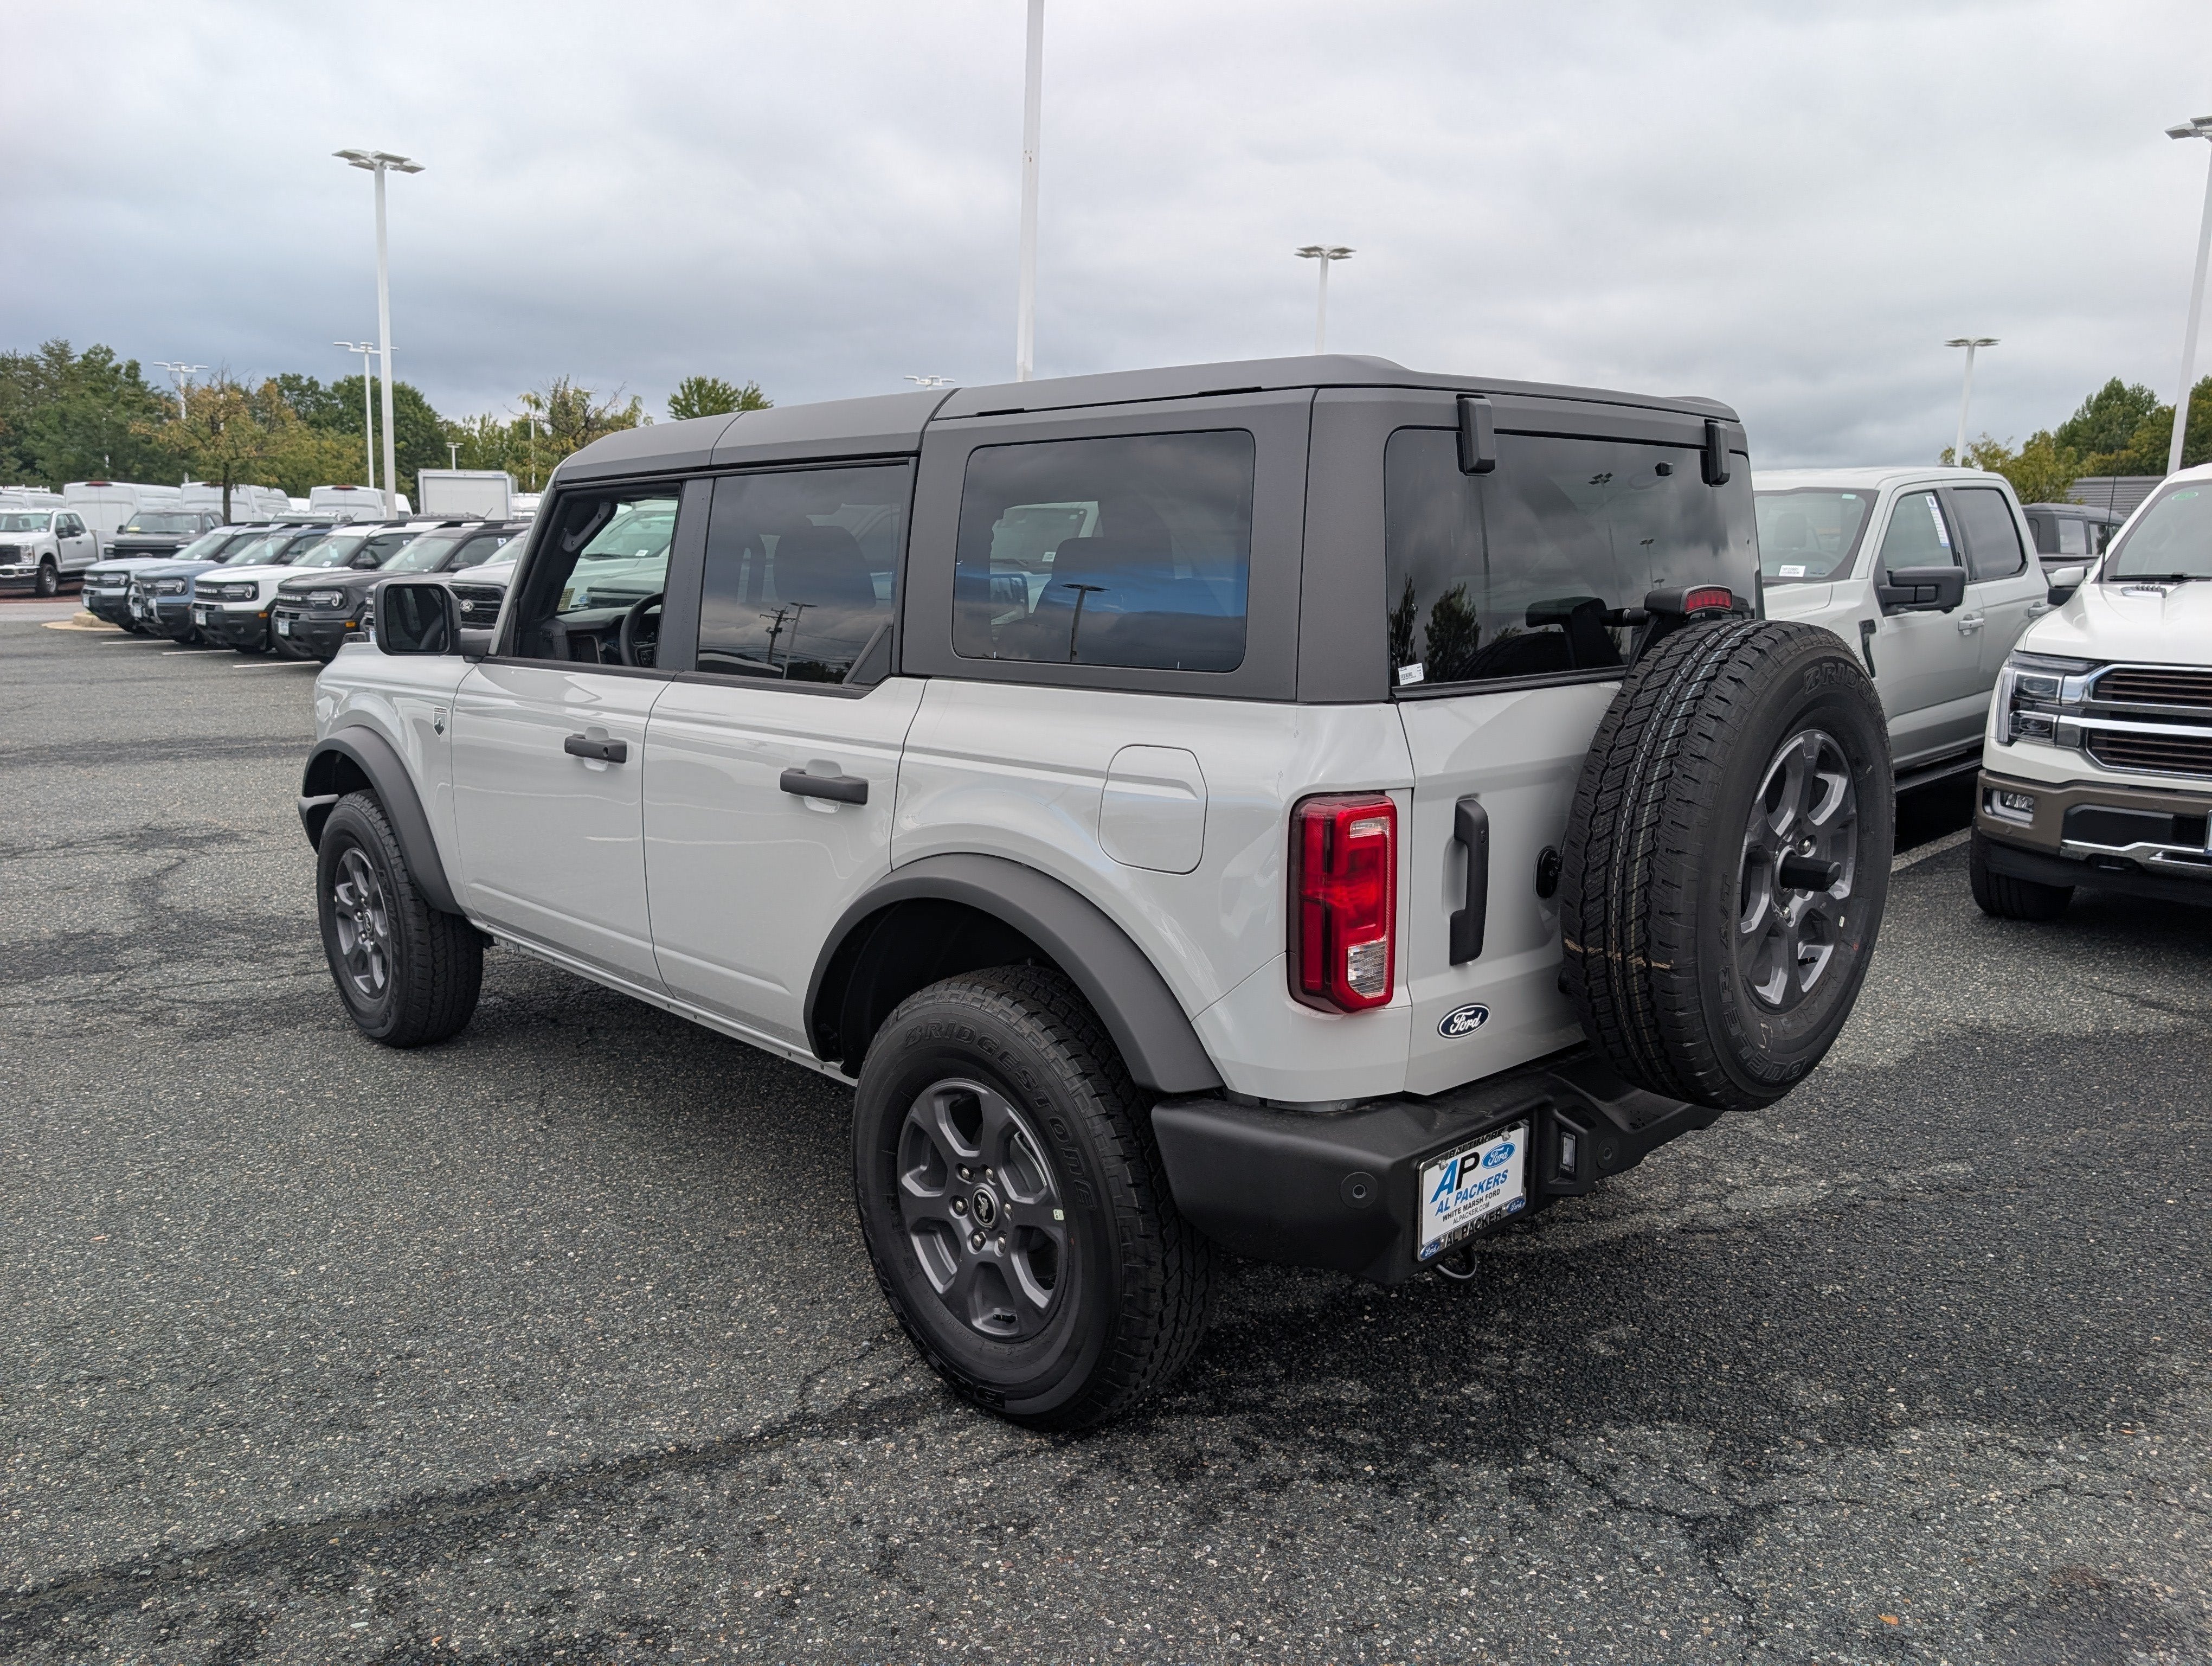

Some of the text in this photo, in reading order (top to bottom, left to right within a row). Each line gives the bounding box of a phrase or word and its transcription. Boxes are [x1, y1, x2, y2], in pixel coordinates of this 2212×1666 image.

[904, 1018, 1096, 1210] BRIDGESTONE
[1429, 1151, 1480, 1204] AP
[1435, 1169, 1508, 1216] AL PACKERS
[1442, 1188, 1501, 1222] WHITE MARSH FORD
[1452, 1201, 1490, 1225] ALPACKER.COM
[1445, 1208, 1502, 1248] AL PACKER
